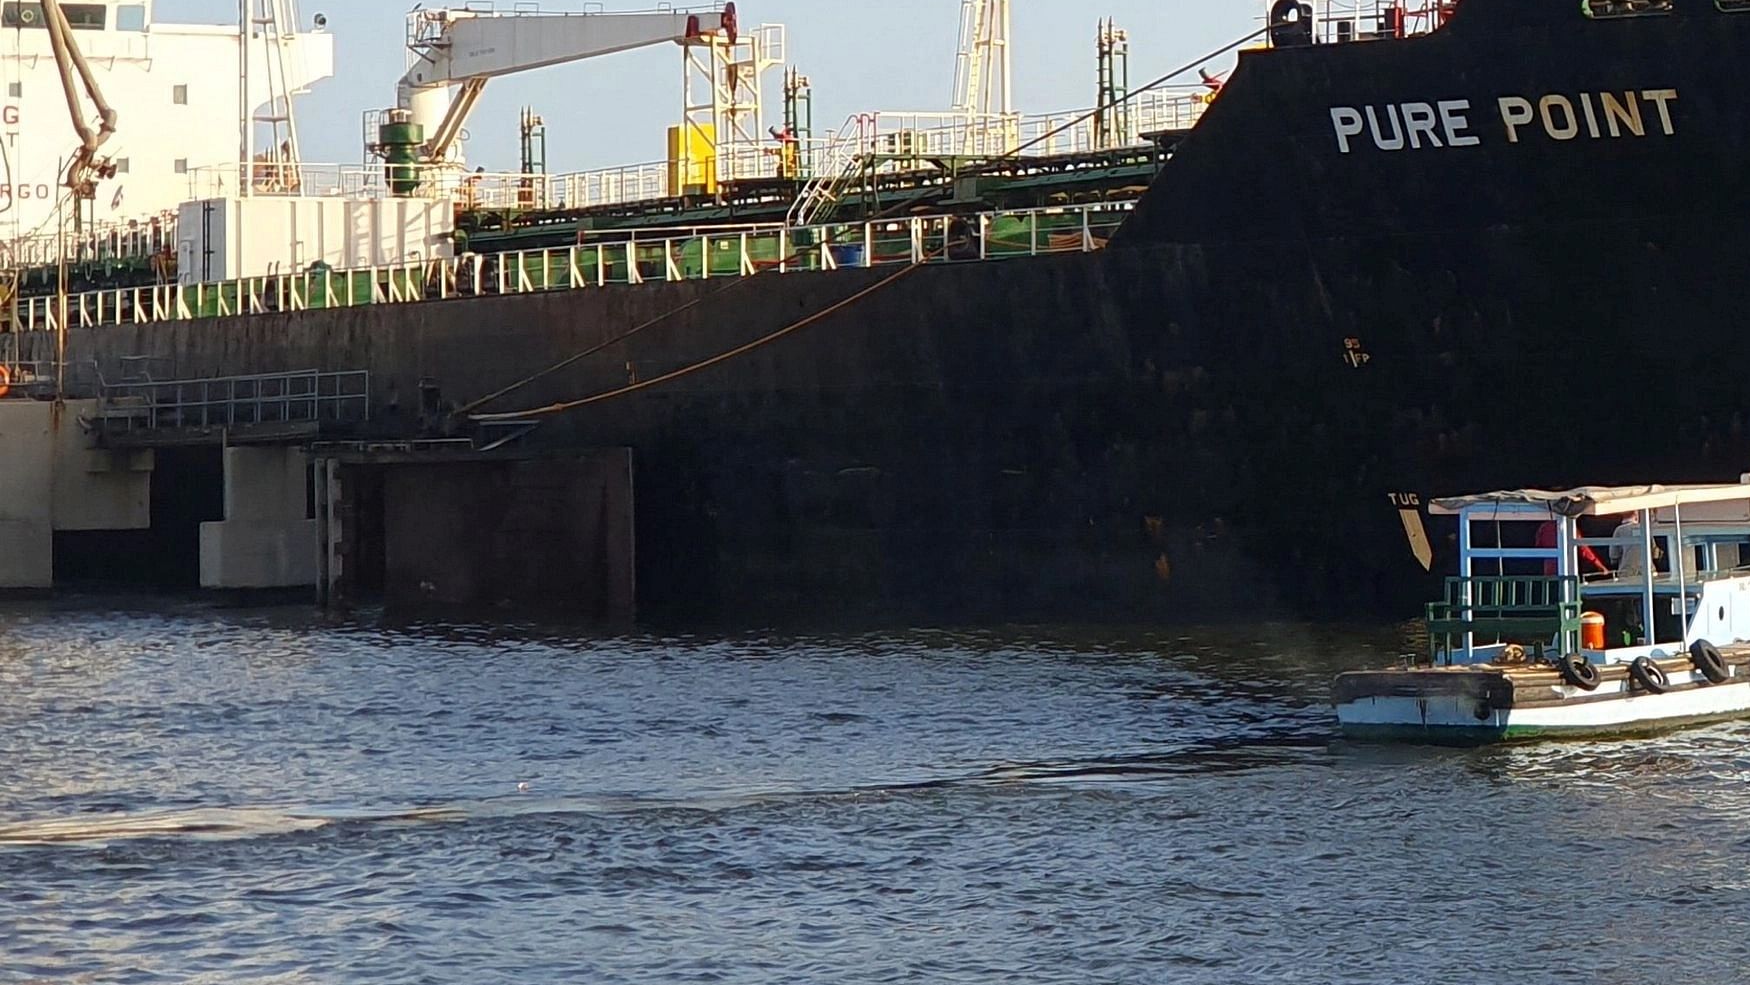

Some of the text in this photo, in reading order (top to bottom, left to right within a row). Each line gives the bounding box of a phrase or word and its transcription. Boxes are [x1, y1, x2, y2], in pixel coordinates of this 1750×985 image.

[1330, 89, 1678, 153] PURE POINT
[1387, 492, 1420, 505] TUG
